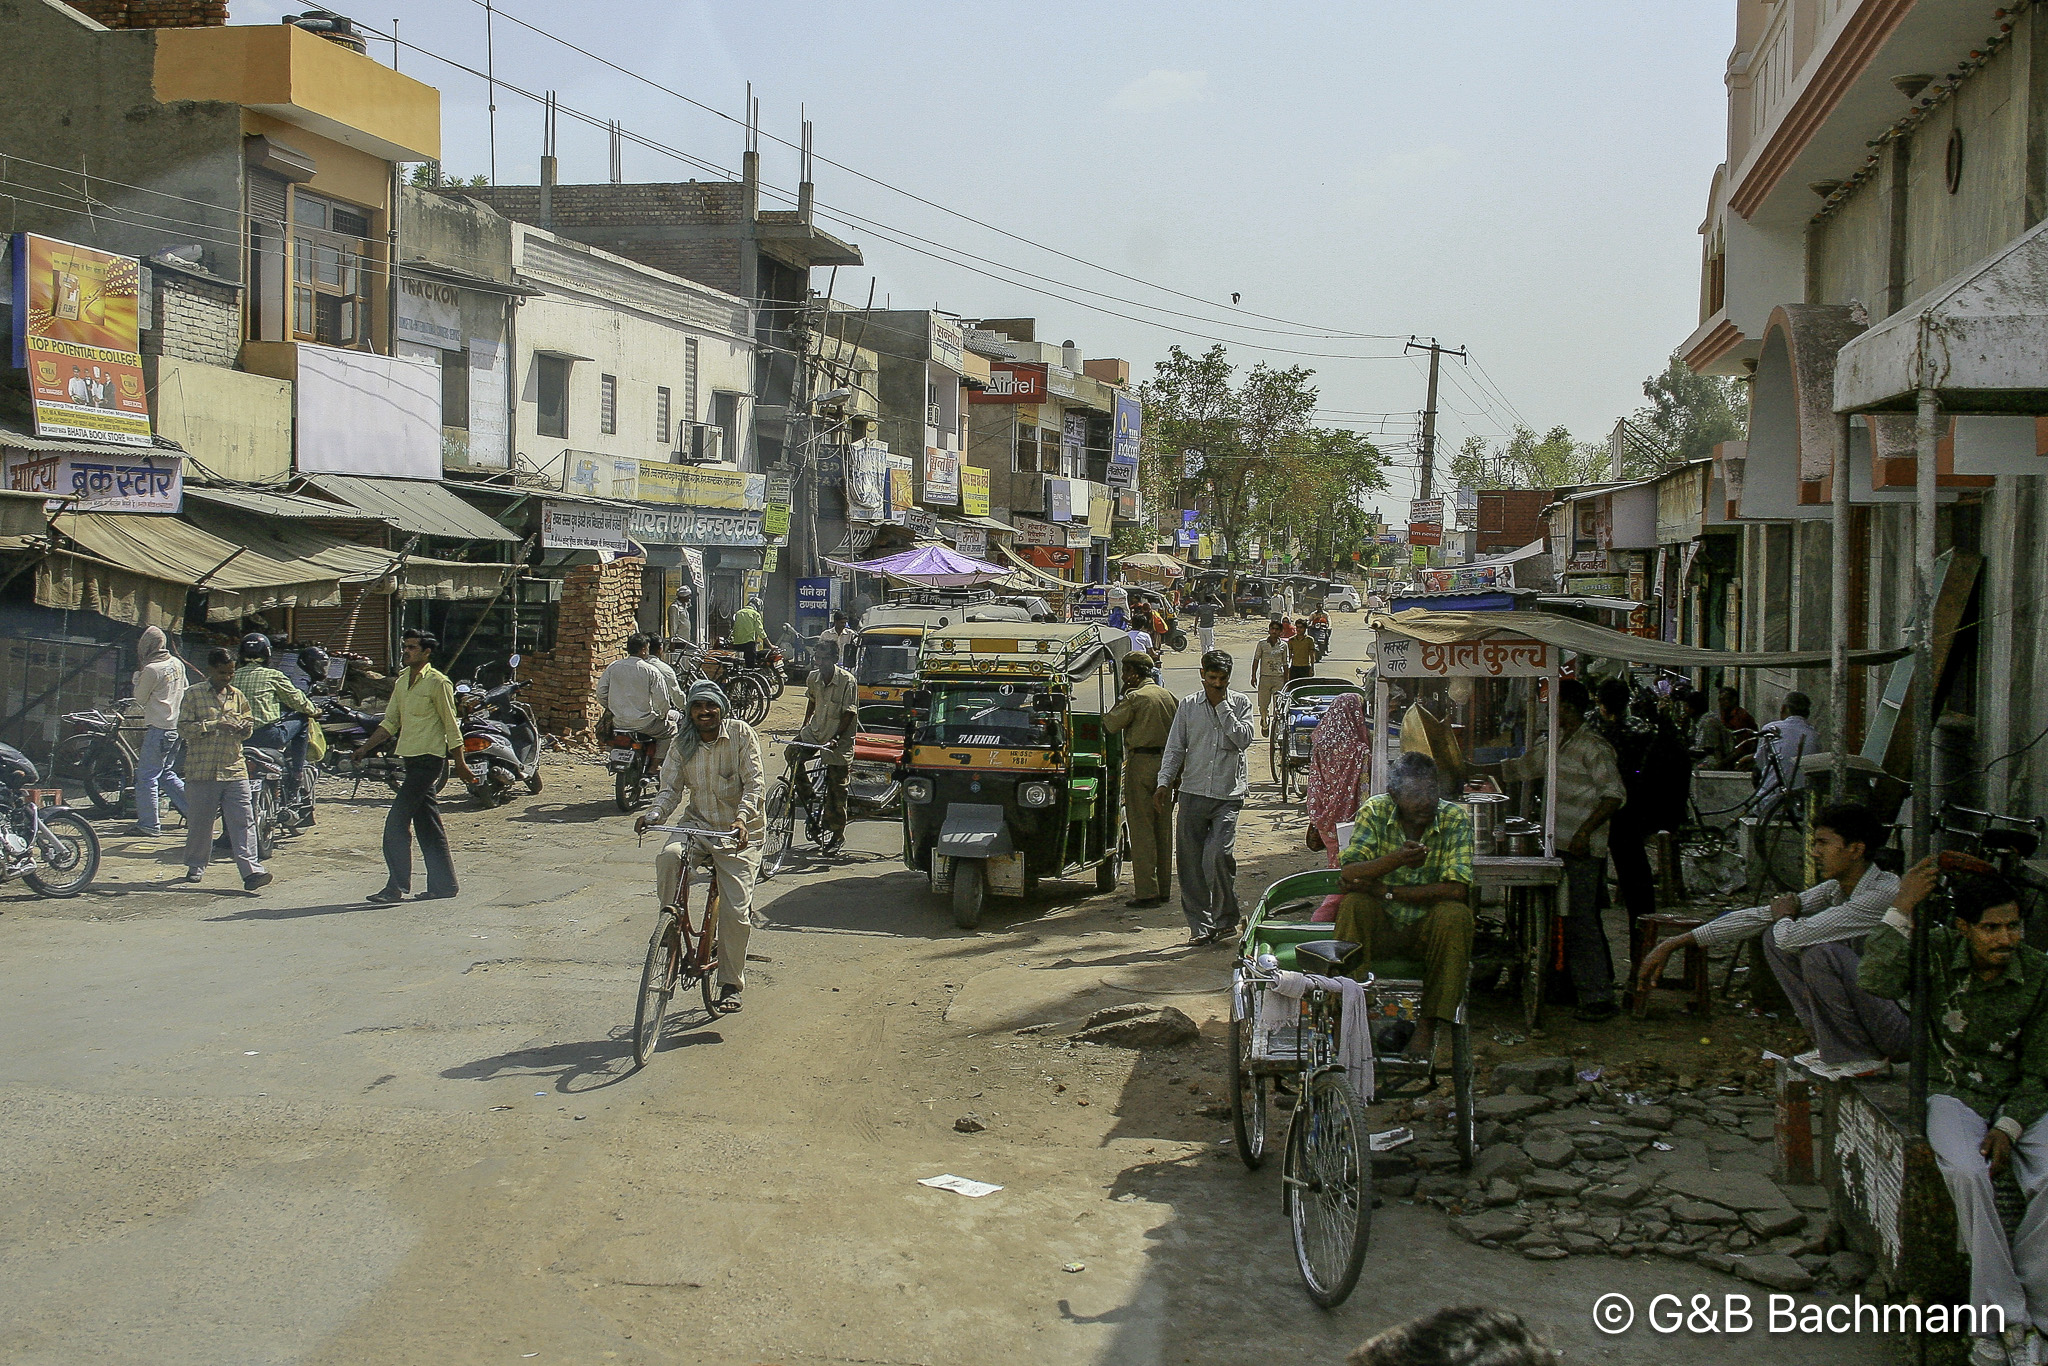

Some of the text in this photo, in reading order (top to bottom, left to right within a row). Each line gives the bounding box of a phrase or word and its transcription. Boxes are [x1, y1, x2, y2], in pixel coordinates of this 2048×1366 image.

[400, 279, 459, 307] TRACKON
[31, 337, 138, 367] TOP POTENTIAL COLLEGE
[986, 376, 1034, 395] Airtel
[38, 401, 64, 409] Changing
[74, 405, 97, 413] Concept
[67, 427, 89, 438] BHATIA
[89, 430, 107, 440] BOOK
[107, 432, 126, 442] STORE
[70, 462, 114, 498] बुक
[116, 456, 174, 498] स्टोर
[799, 584, 827, 597] पीने का
[1387, 655, 1407, 674] वाले
